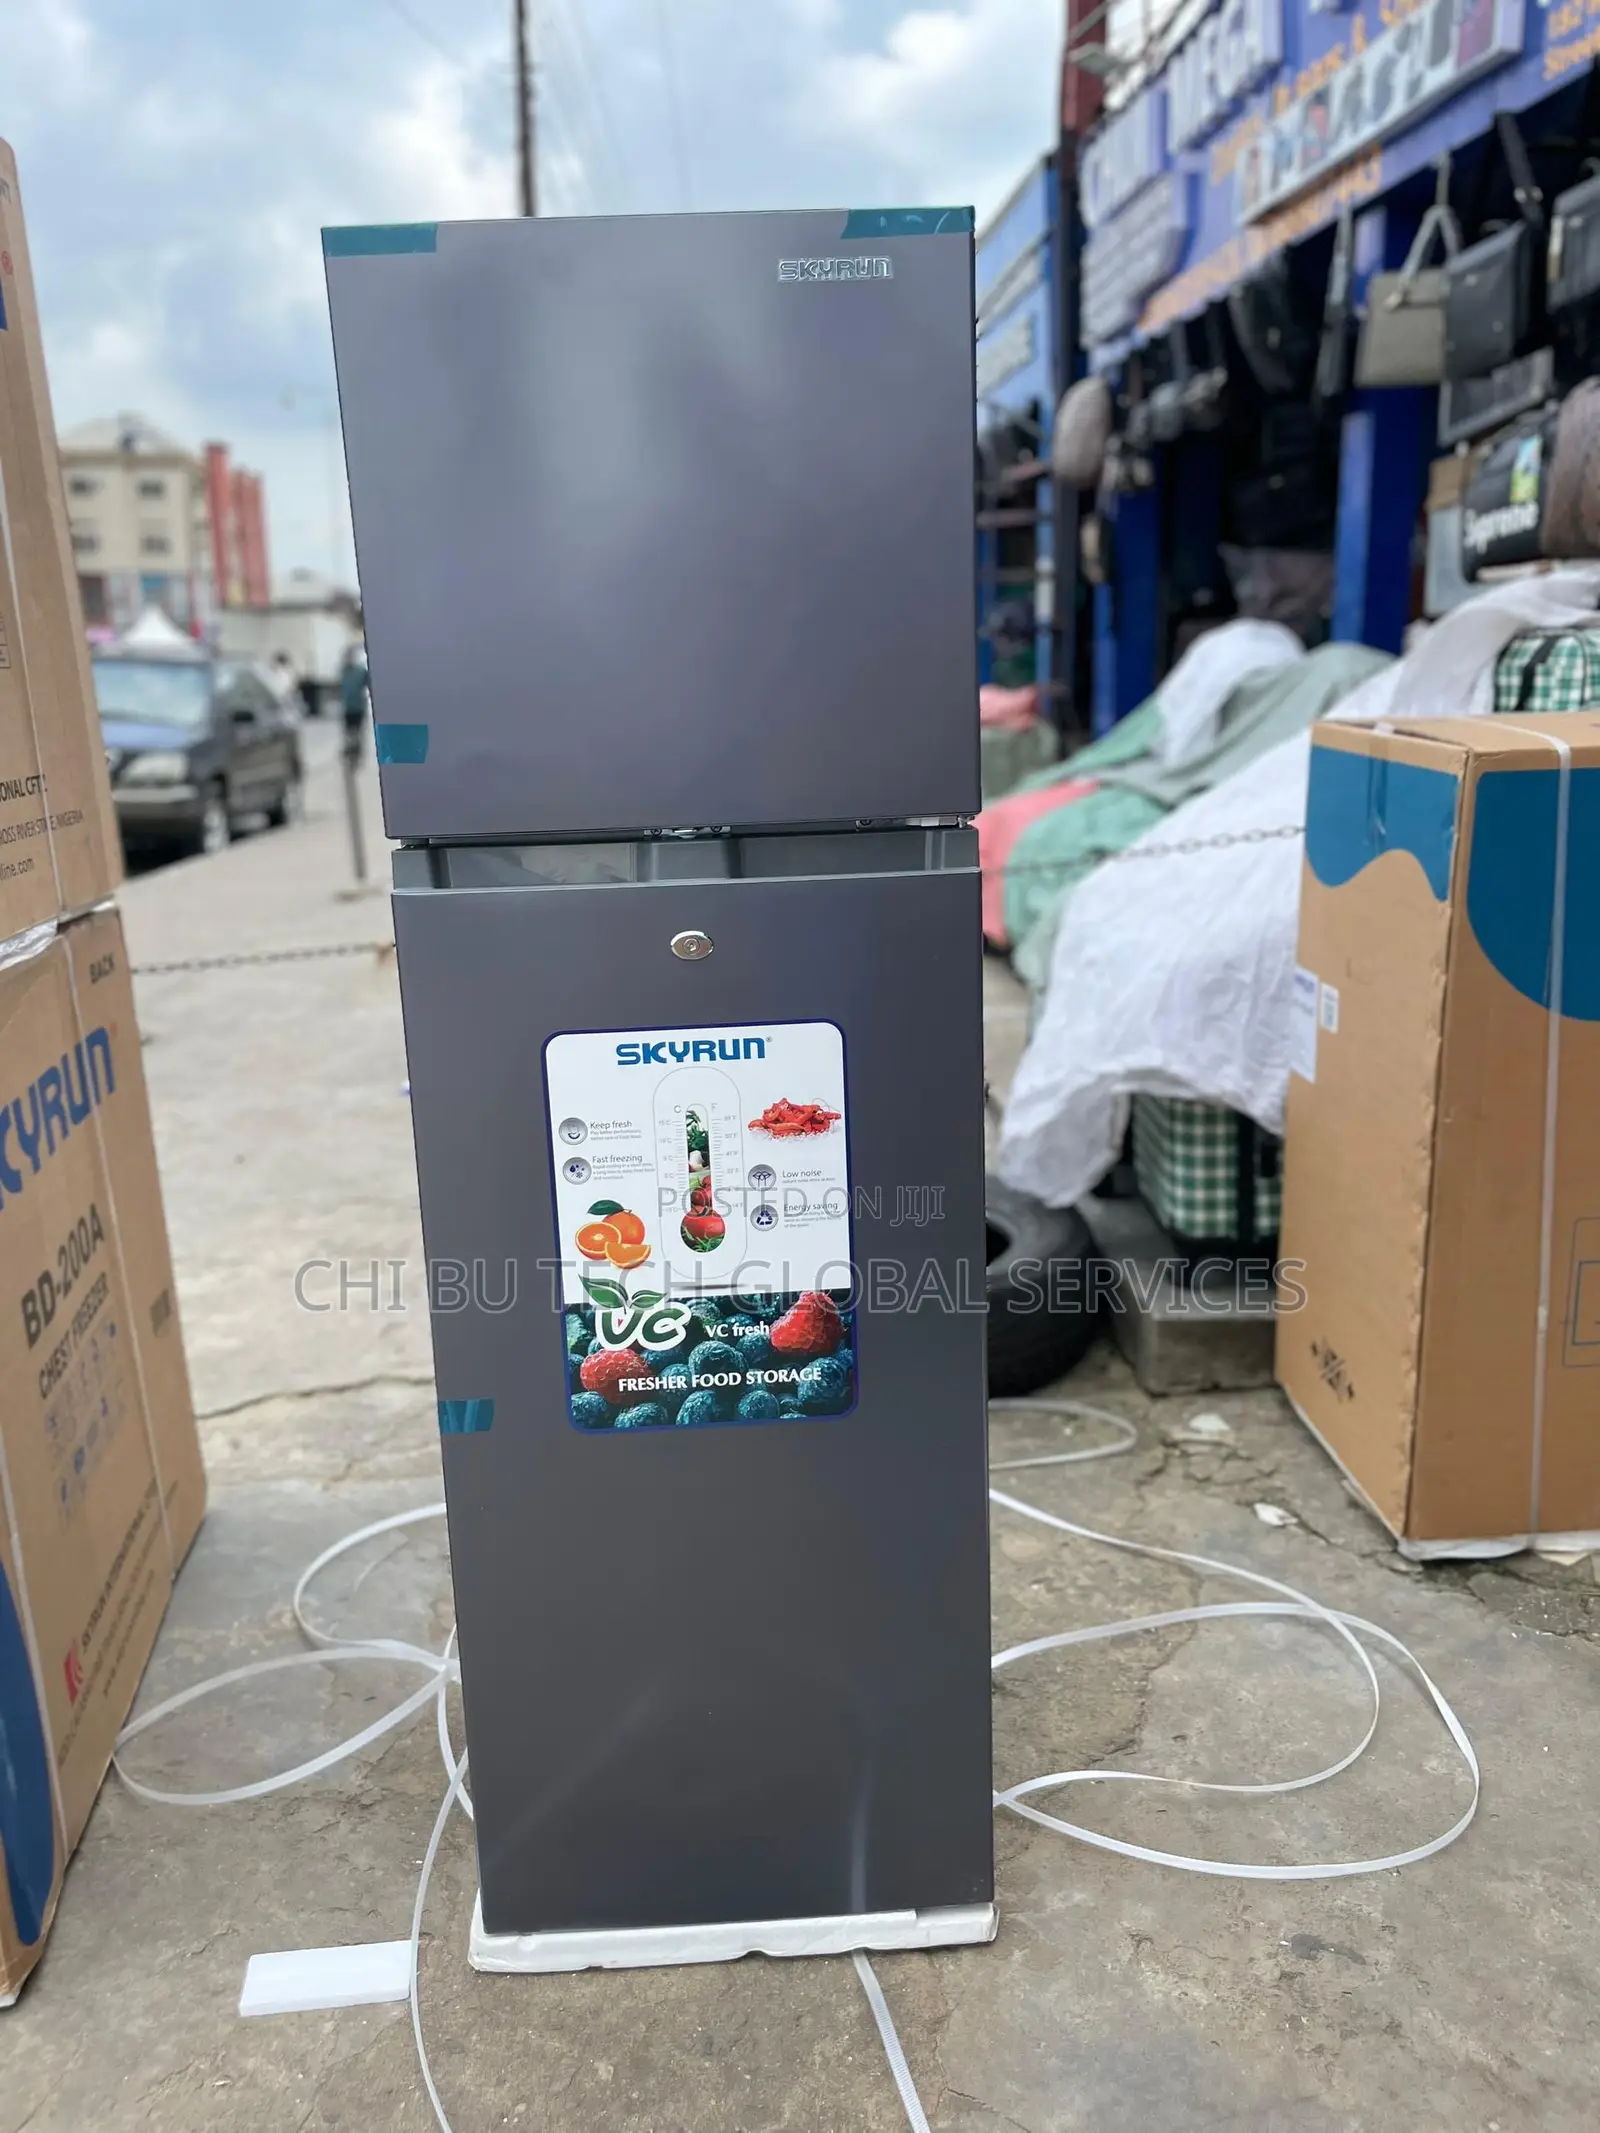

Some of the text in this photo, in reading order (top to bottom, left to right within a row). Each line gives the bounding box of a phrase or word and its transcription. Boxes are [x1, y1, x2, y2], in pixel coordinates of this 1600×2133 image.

[779, 256, 893, 281] SKYRUN
[90, 953, 115, 984] BACK
[616, 1038, 765, 1066] SKYRUN
[590, 1120, 633, 1130] Keep fresh
[592, 1154, 643, 1163] Fast freezing
[782, 1169, 822, 1178] Low noise
[784, 1203, 811, 1213] Energy
[21, 1203, 104, 1351] BD-200A
[600, 1306, 687, 1345] VC
[705, 1320, 770, 1338] VC fresh
[618, 1367, 822, 1392] FRESHER FOOD STORAGE
